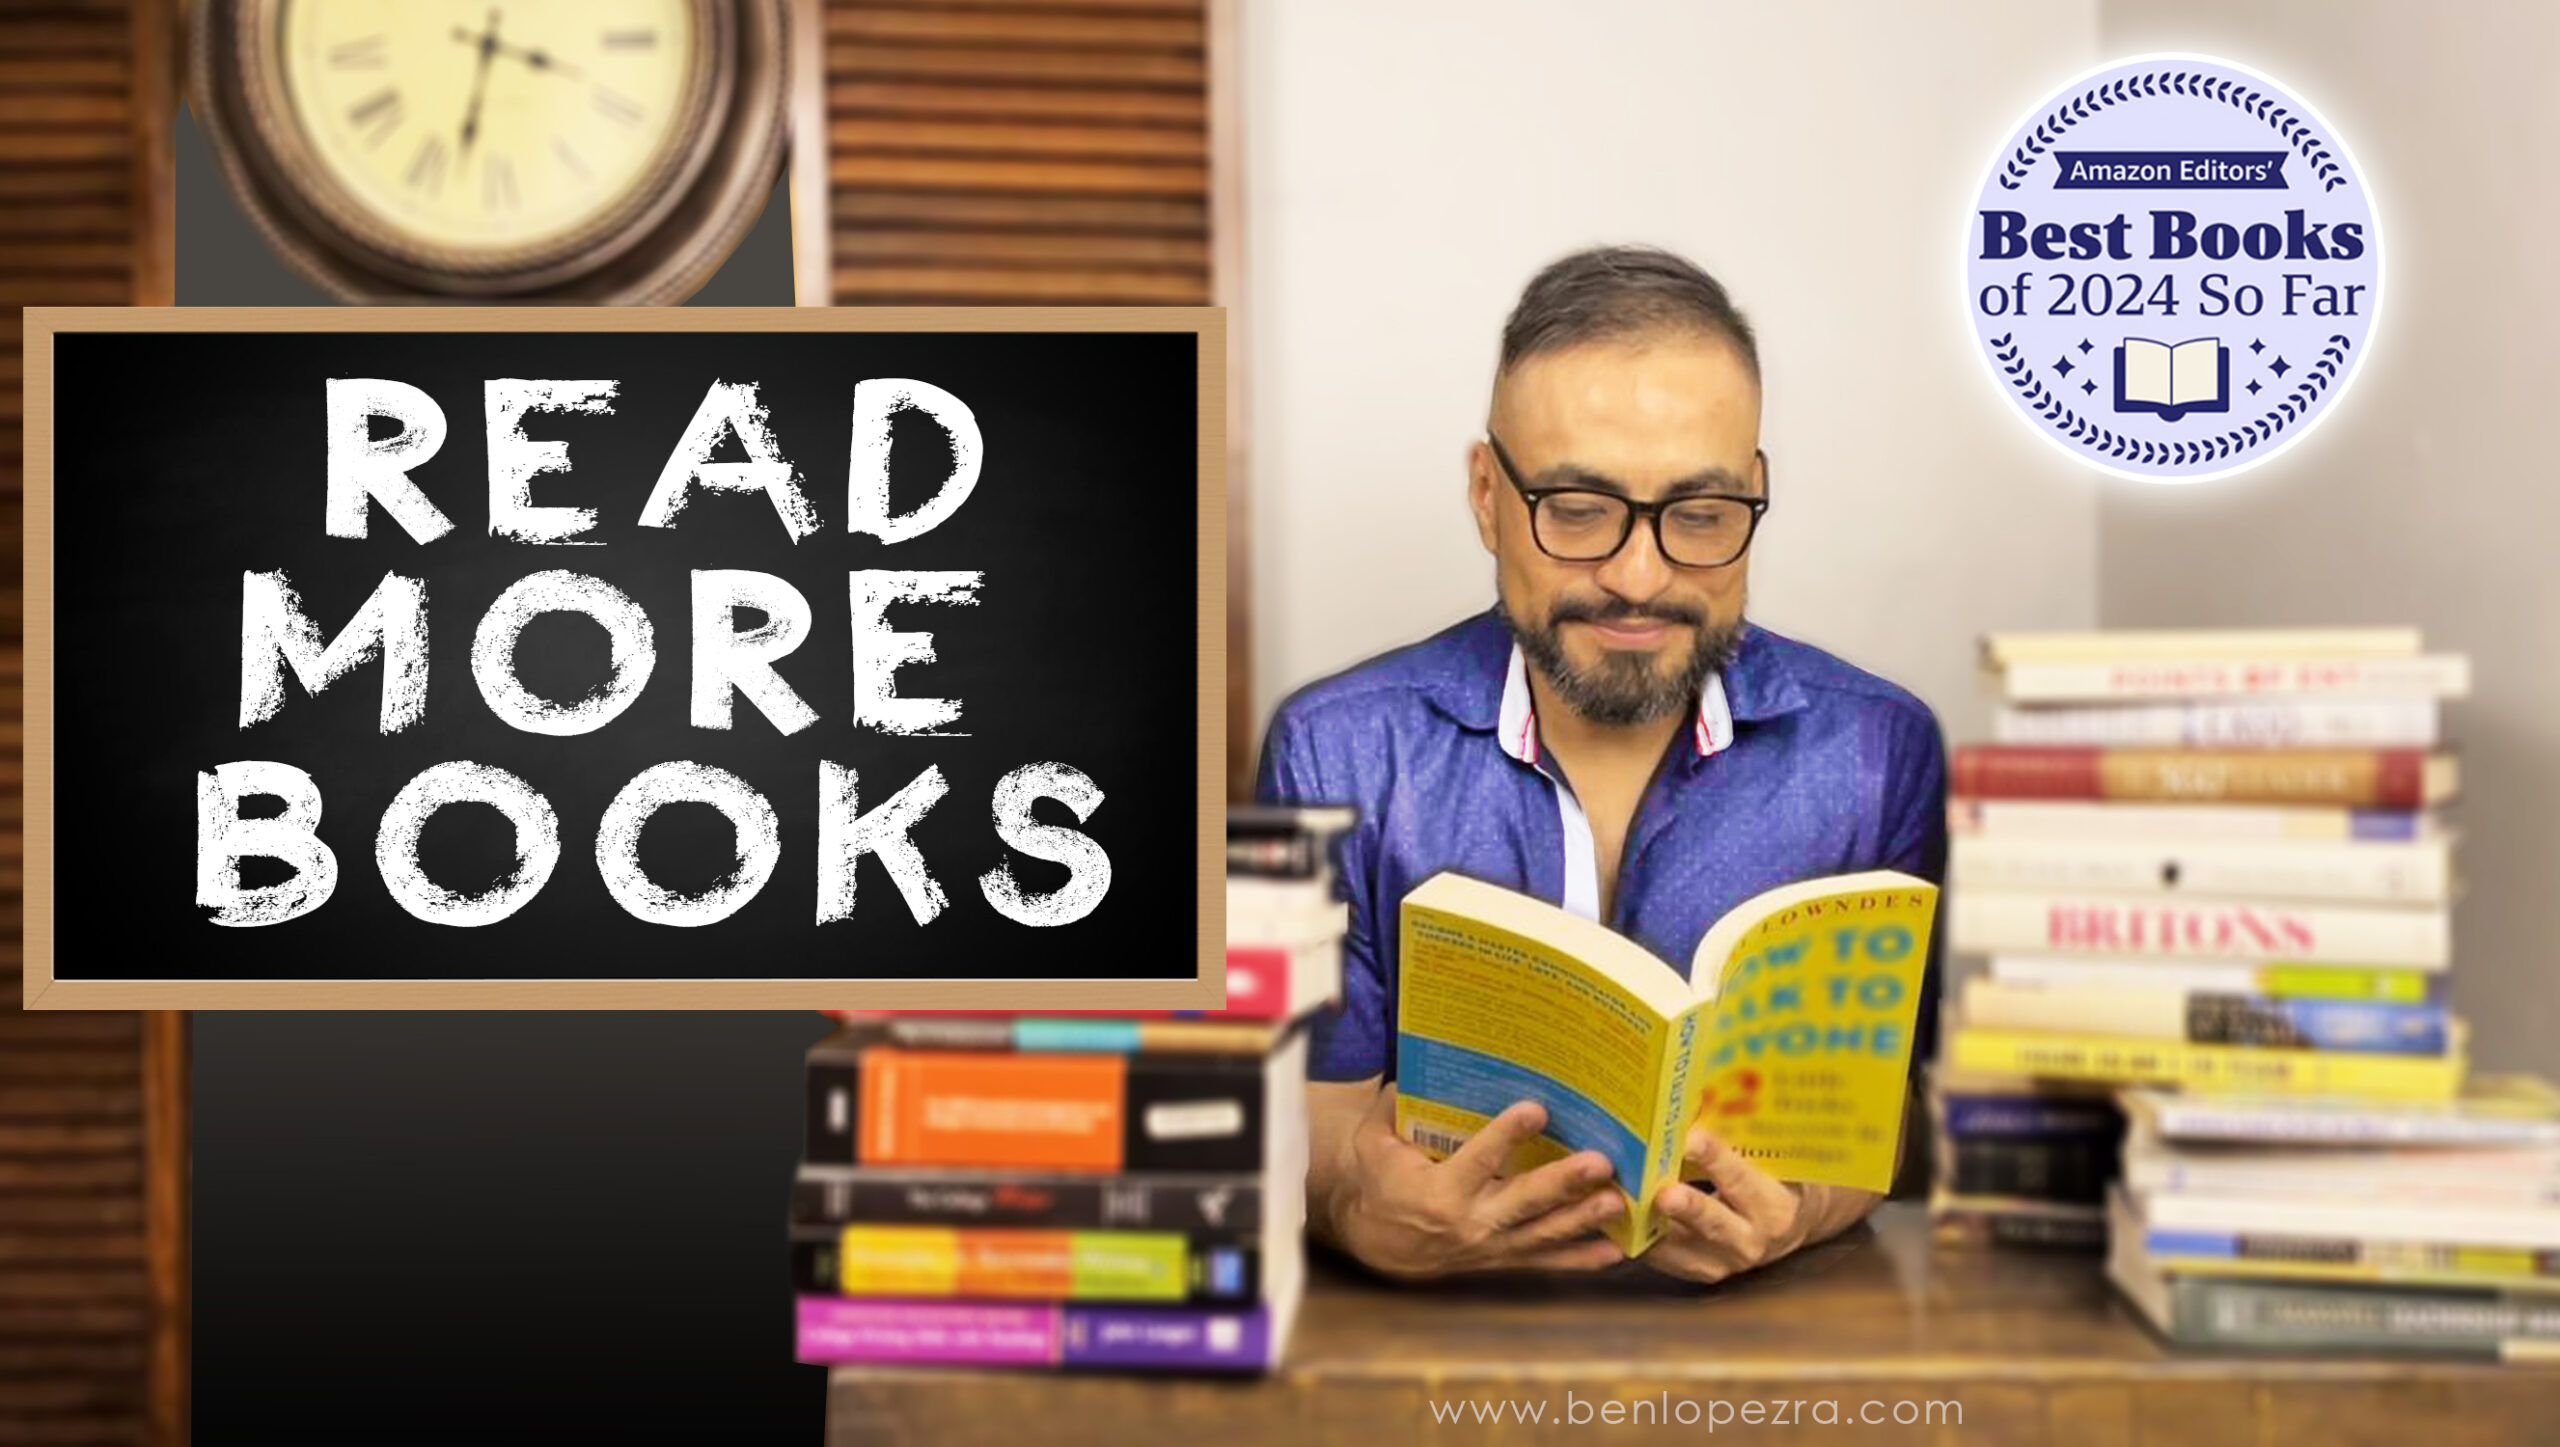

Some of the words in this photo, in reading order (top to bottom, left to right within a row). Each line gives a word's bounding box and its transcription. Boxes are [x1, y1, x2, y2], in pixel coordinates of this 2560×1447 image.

[1762, 894, 1924, 934] LOWNDES
[2047, 903, 2315, 955] BRITONS
[1832, 923, 1915, 964] TO
[1828, 973, 1906, 1012] TO
